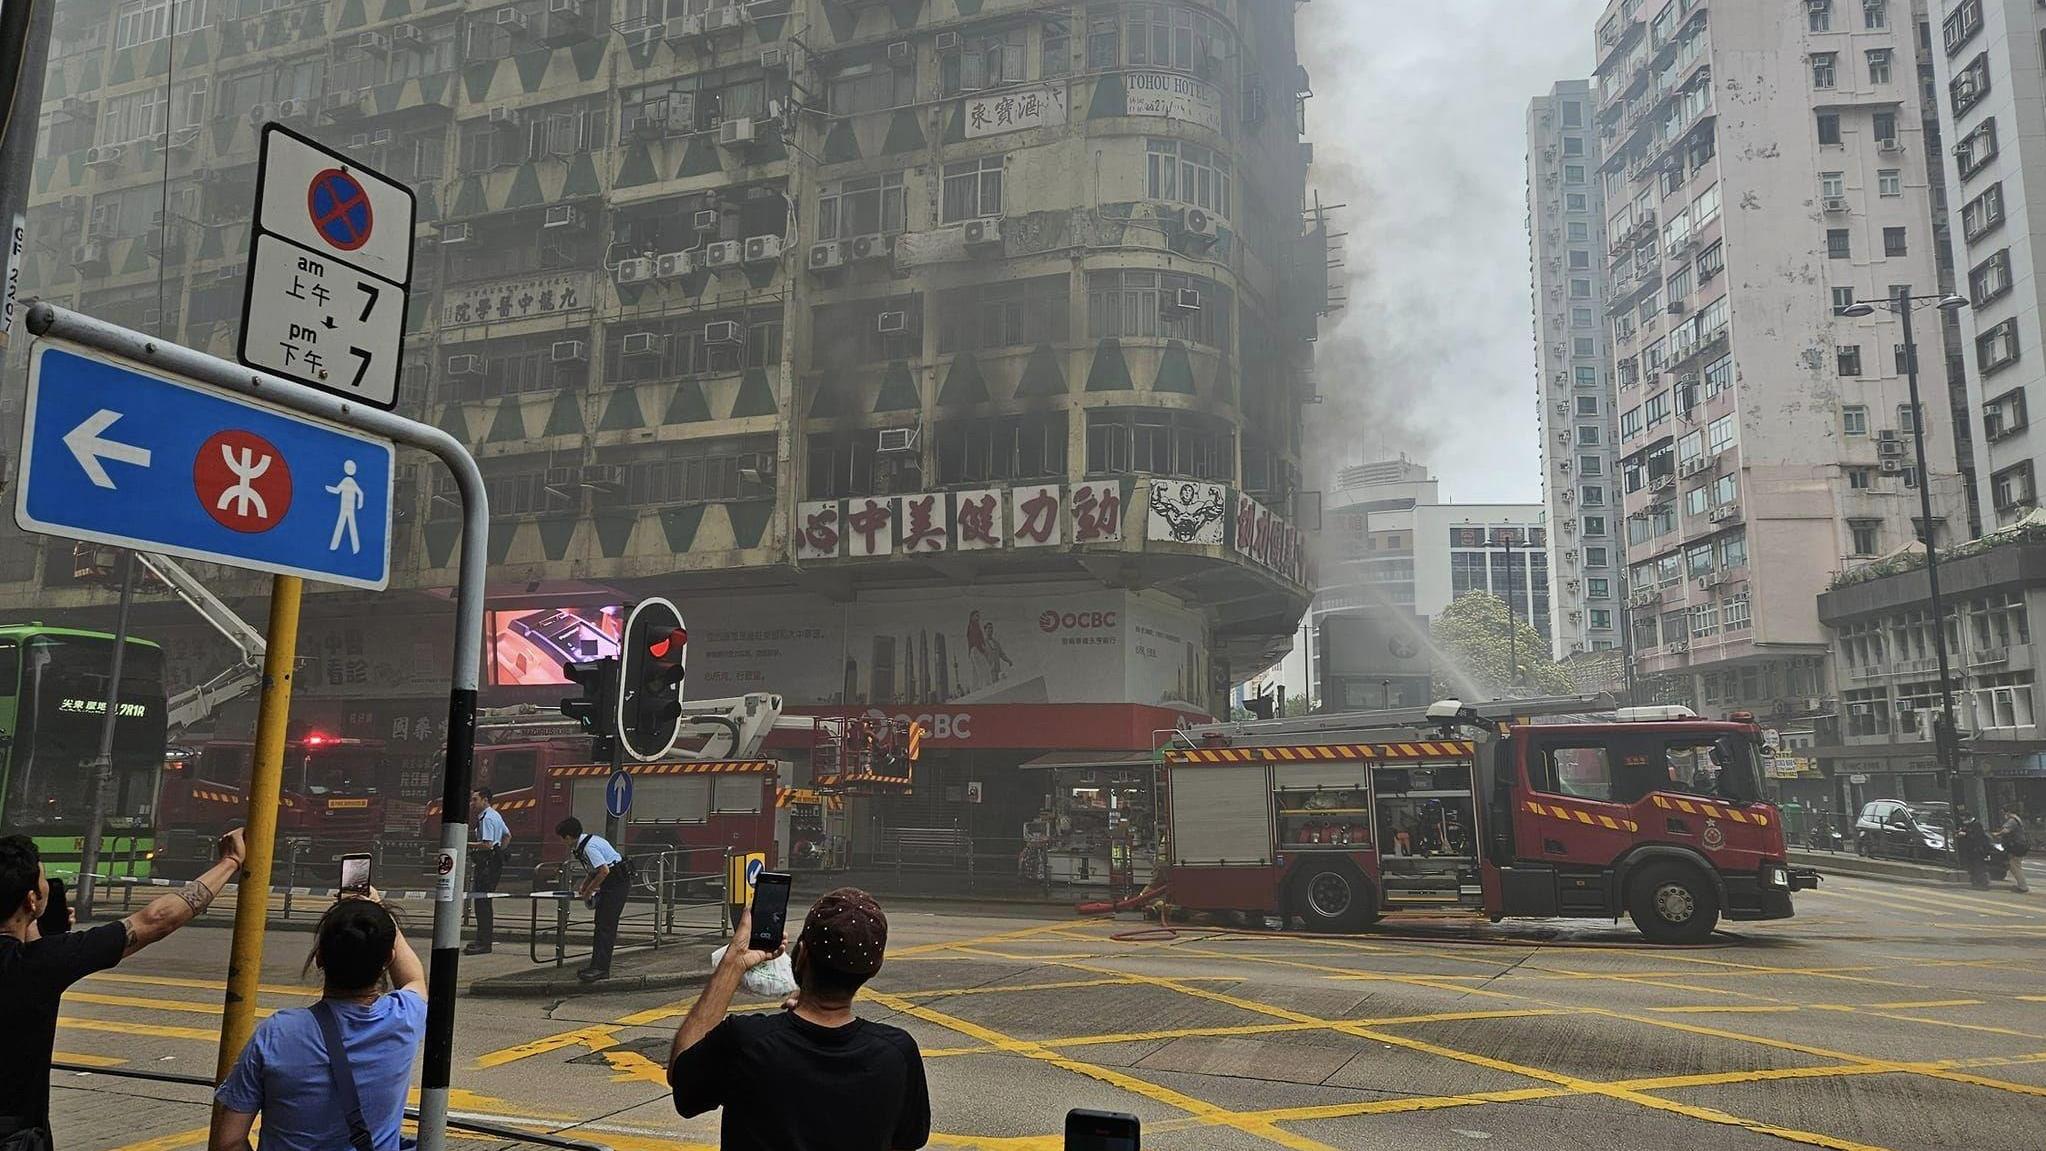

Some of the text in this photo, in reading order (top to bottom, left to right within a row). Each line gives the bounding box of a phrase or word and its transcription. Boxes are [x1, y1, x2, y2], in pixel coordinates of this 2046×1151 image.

[1128, 74, 1208, 100] TOHOU HOTEL
[297, 256, 324, 278] am
[285, 275, 379, 323] 上午 7
[289, 322, 317, 344] pm
[279, 341, 372, 387] 下午 7
[1061, 612, 1117, 629] OCBC
